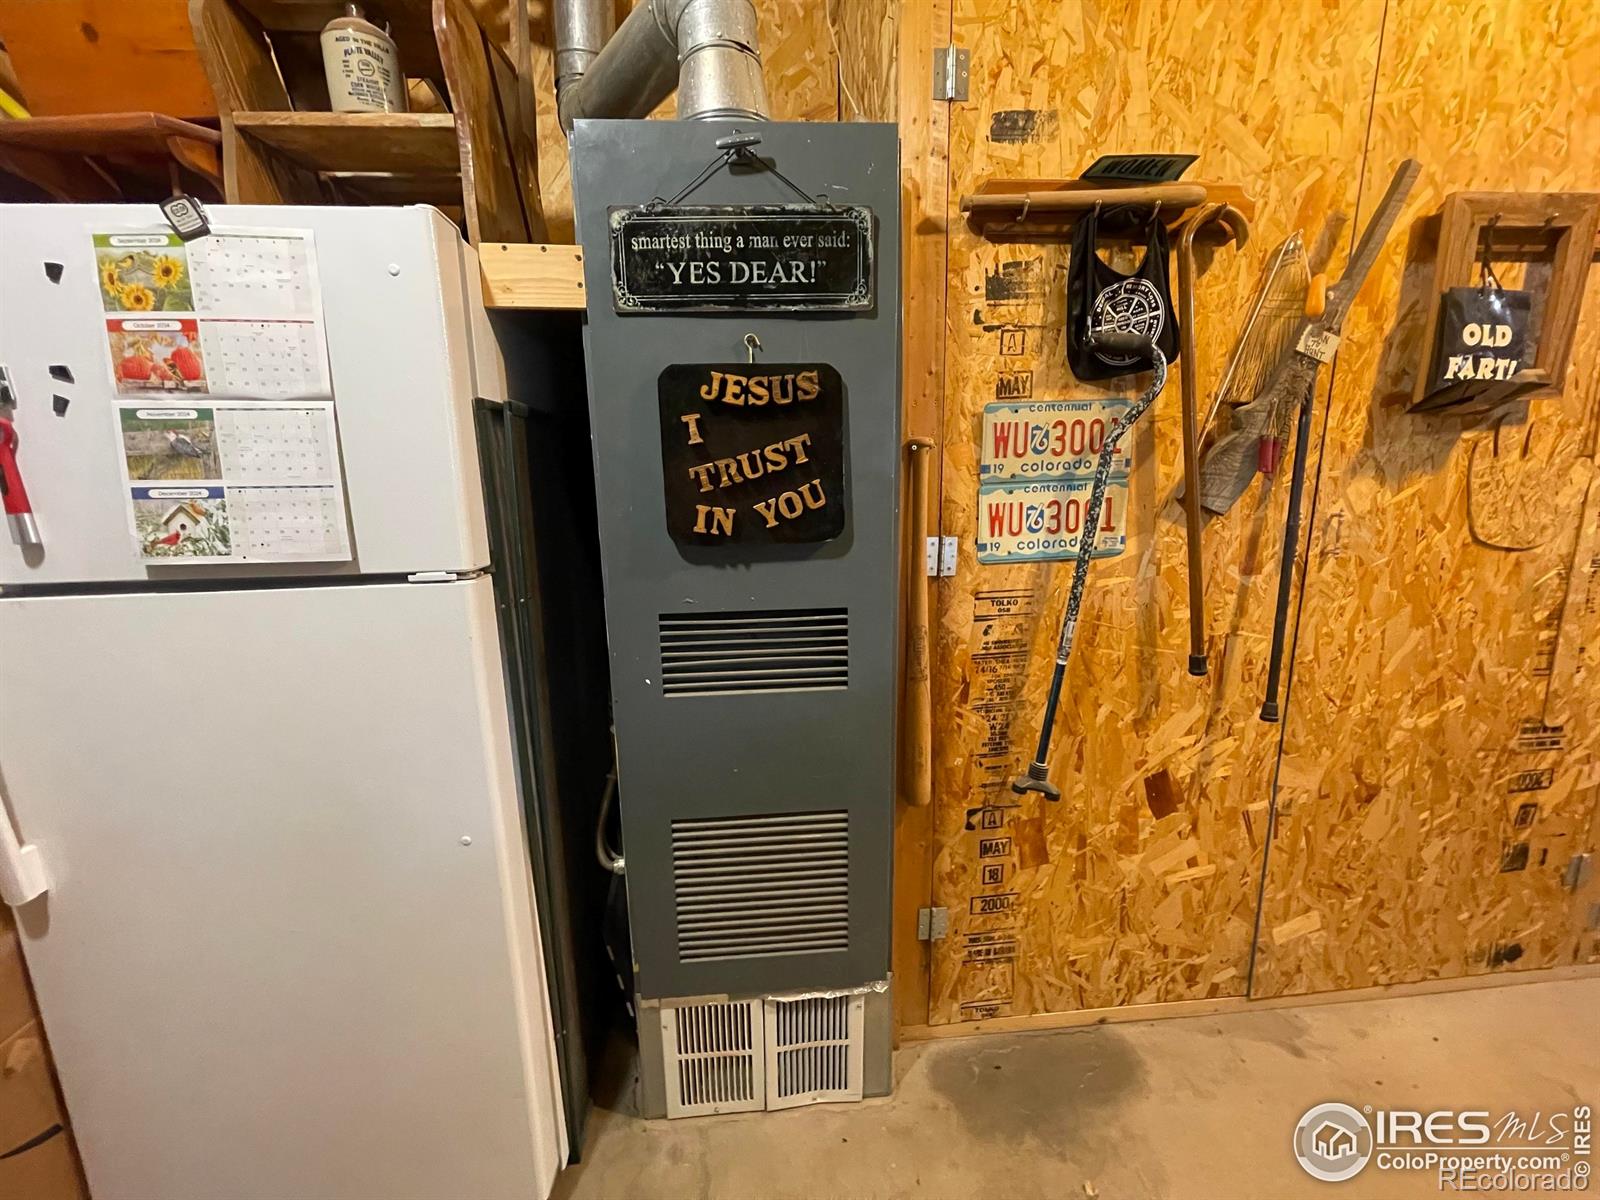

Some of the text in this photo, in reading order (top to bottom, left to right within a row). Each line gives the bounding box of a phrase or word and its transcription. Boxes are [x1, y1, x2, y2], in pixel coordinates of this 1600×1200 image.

[343, 46, 363, 57] PLATE
[1102, 156, 1178, 177] WOMEN
[631, 230, 850, 253] smartest thing a man ever said:
[1462, 323, 1513, 348] OLD
[1444, 354, 1518, 380] FART!
[700, 370, 820, 406] JESUS
[999, 375, 1029, 395] MAY
[1029, 403, 1092, 413] centennial
[681, 413, 704, 445] I
[993, 421, 1029, 458] WU
[688, 433, 812, 492] TRUST
[993, 459, 1092, 474] 19 colorado
[1024, 482, 1088, 493] centennial
[693, 479, 826, 536] IN YOU
[988, 501, 1024, 538] WU
[1046, 496, 1116, 535] 301
[989, 536, 1086, 552] 19 colorad
[990, 598, 1019, 607] TOLKO
[988, 812, 997, 826] A
[982, 841, 1009, 856] MAY
[987, 867, 999, 881] 18
[980, 897, 1010, 912] 2000
